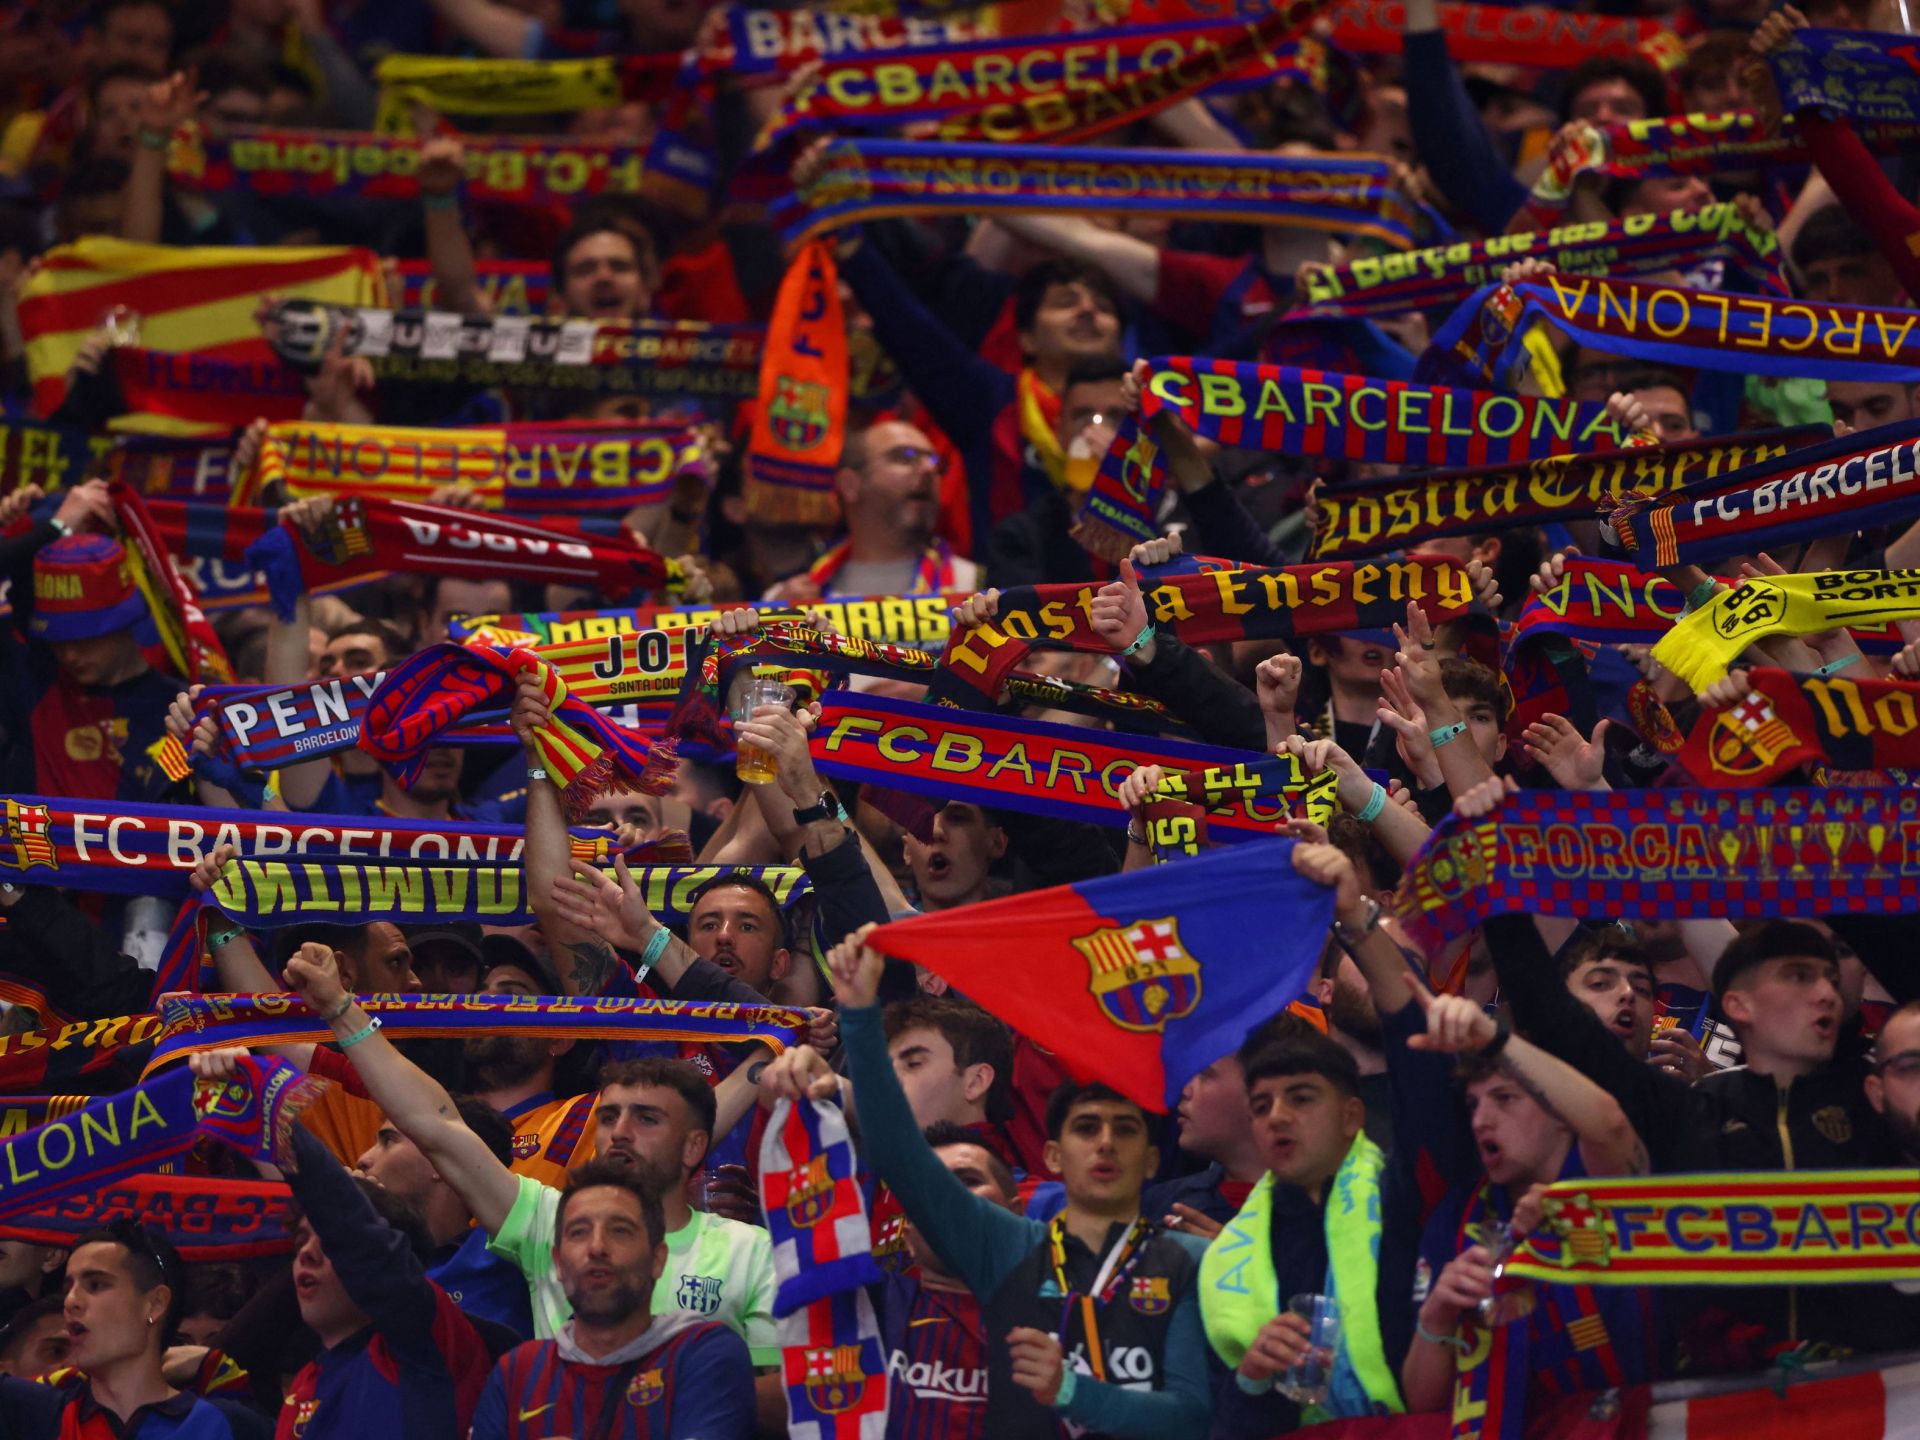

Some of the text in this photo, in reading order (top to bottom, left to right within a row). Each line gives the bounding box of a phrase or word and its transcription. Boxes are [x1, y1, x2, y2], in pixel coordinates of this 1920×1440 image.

[949, 562, 1474, 675] Nosta Enseny
[1723, 582, 1779, 627] BVB
[609, 678, 651, 696] SANTA
[73, 813, 147, 866] FC
[1500, 823, 1719, 882] FORÇA
